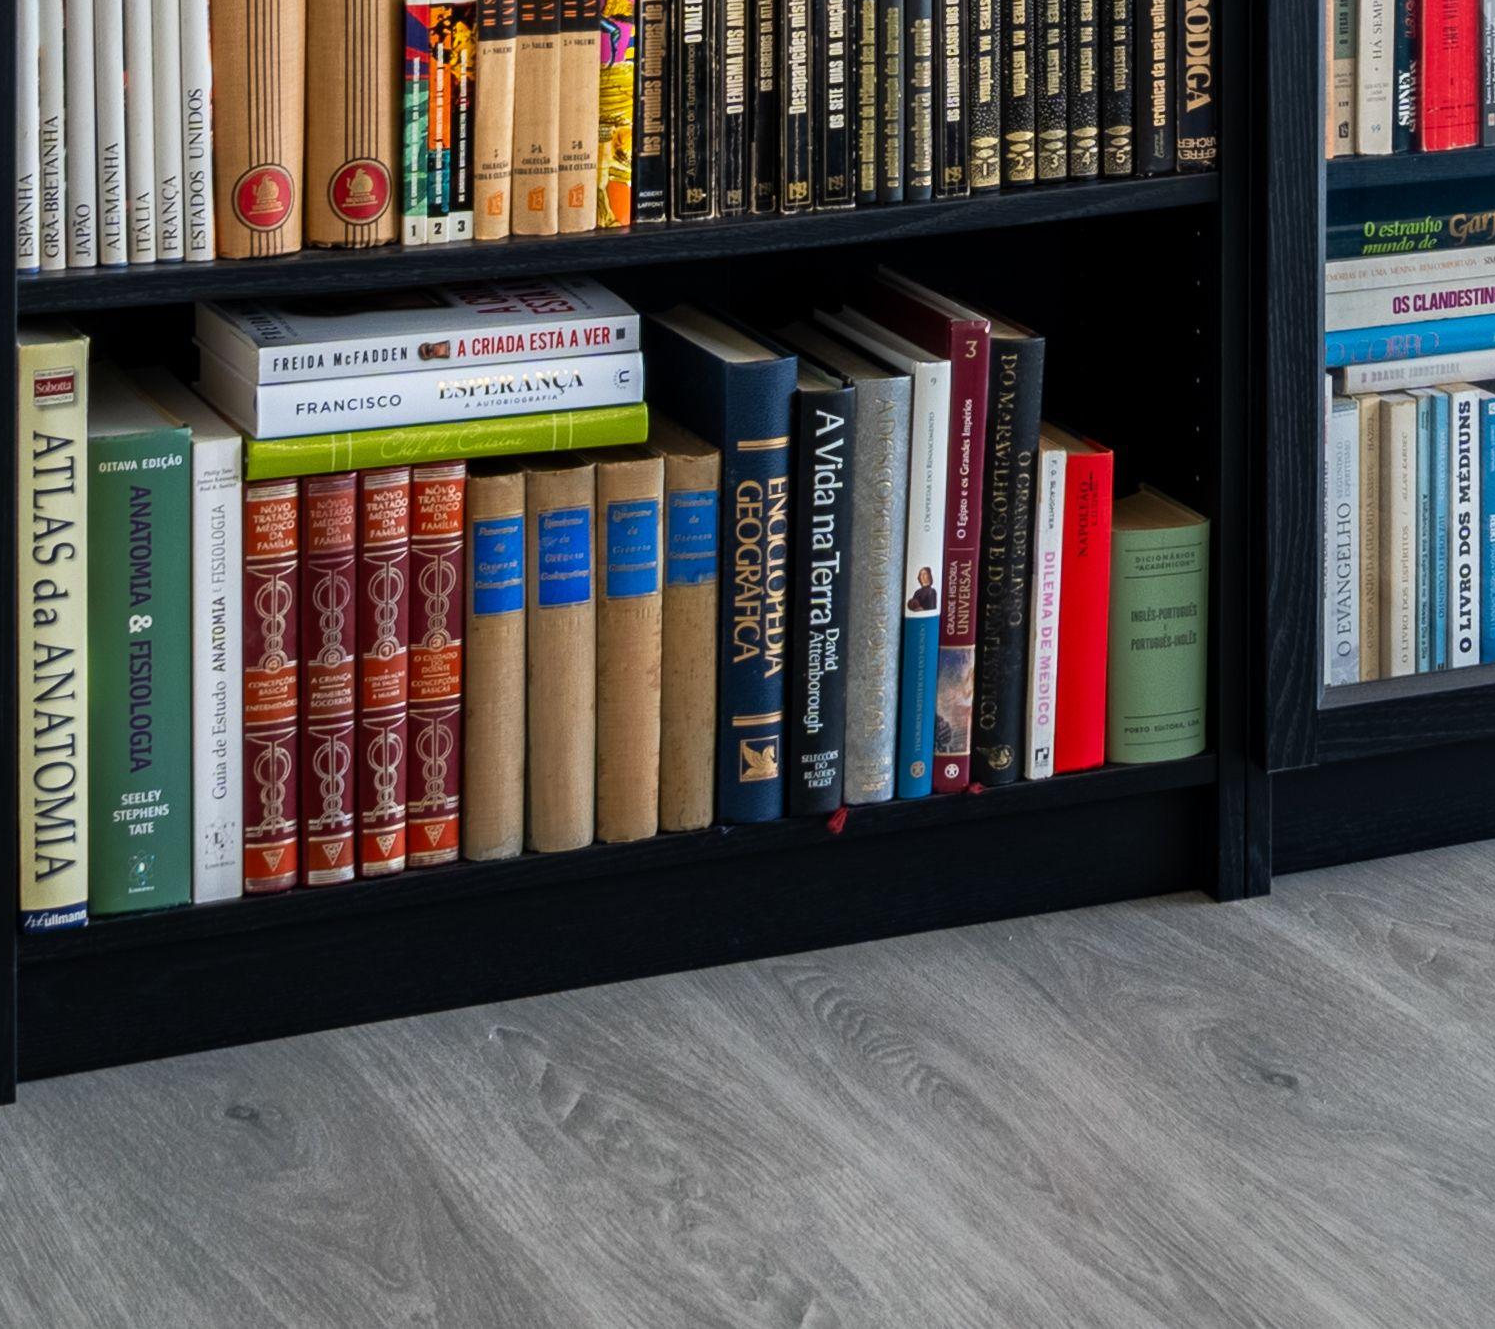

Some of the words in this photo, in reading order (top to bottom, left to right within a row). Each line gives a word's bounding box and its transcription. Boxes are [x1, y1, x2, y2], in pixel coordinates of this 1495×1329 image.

[188, 88, 203, 159] UNIDOS
[42, 116, 59, 258] GRÃ-BRETANHA
[104, 143, 120, 250] ALEMANHA
[190, 170, 205, 250] ESTADOS
[18, 173, 33, 258] ESPANHA
[73, 204, 90, 256] JAPÃO
[132, 192, 151, 253] ITÁLIA
[161, 176, 179, 251] FRANÇA
[1392, 293, 1410, 314] OS
[273, 354, 324, 373] FREIDA
[333, 347, 407, 367] McFADDEN
[457, 339, 467, 357] A
[472, 334, 524, 356] CRIADA
[530, 327, 564, 352] ESTÁ
[569, 330, 578, 346] A
[583, 327, 610, 345] VER
[35, 379, 73, 395] Sobotta
[296, 395, 402, 415] FRANCISCO
[438, 369, 583, 400] ESPERANÇA
[816, 409, 844, 436] A
[98, 459, 138, 472] OITAVA
[142, 455, 182, 471] EDIÇÃO
[813, 439, 844, 503] Vida
[1457, 400, 1471, 504] MÉDIUNS
[32, 431, 75, 567] ATLAS
[128, 485, 152, 607] ANATOMIA
[812, 512, 835, 551] na
[1459, 511, 1471, 557] DOS
[733, 480, 764, 662] GEOGRÁFICA
[810, 550, 840, 629] Terra
[32, 579, 74, 629] da
[128, 613, 152, 633] &
[1459, 563, 1471, 632] LIVRO
[824, 628, 839, 671] David
[1459, 639, 1472, 653] O
[129, 641, 152, 773] FISIOLOGIA
[803, 630, 821, 735] Attenborough
[32, 640, 77, 883] ANATOMIA
[112, 802, 169, 823] STEPHENS
[121, 789, 162, 806] SEELEY
[128, 820, 154, 836] TATE
